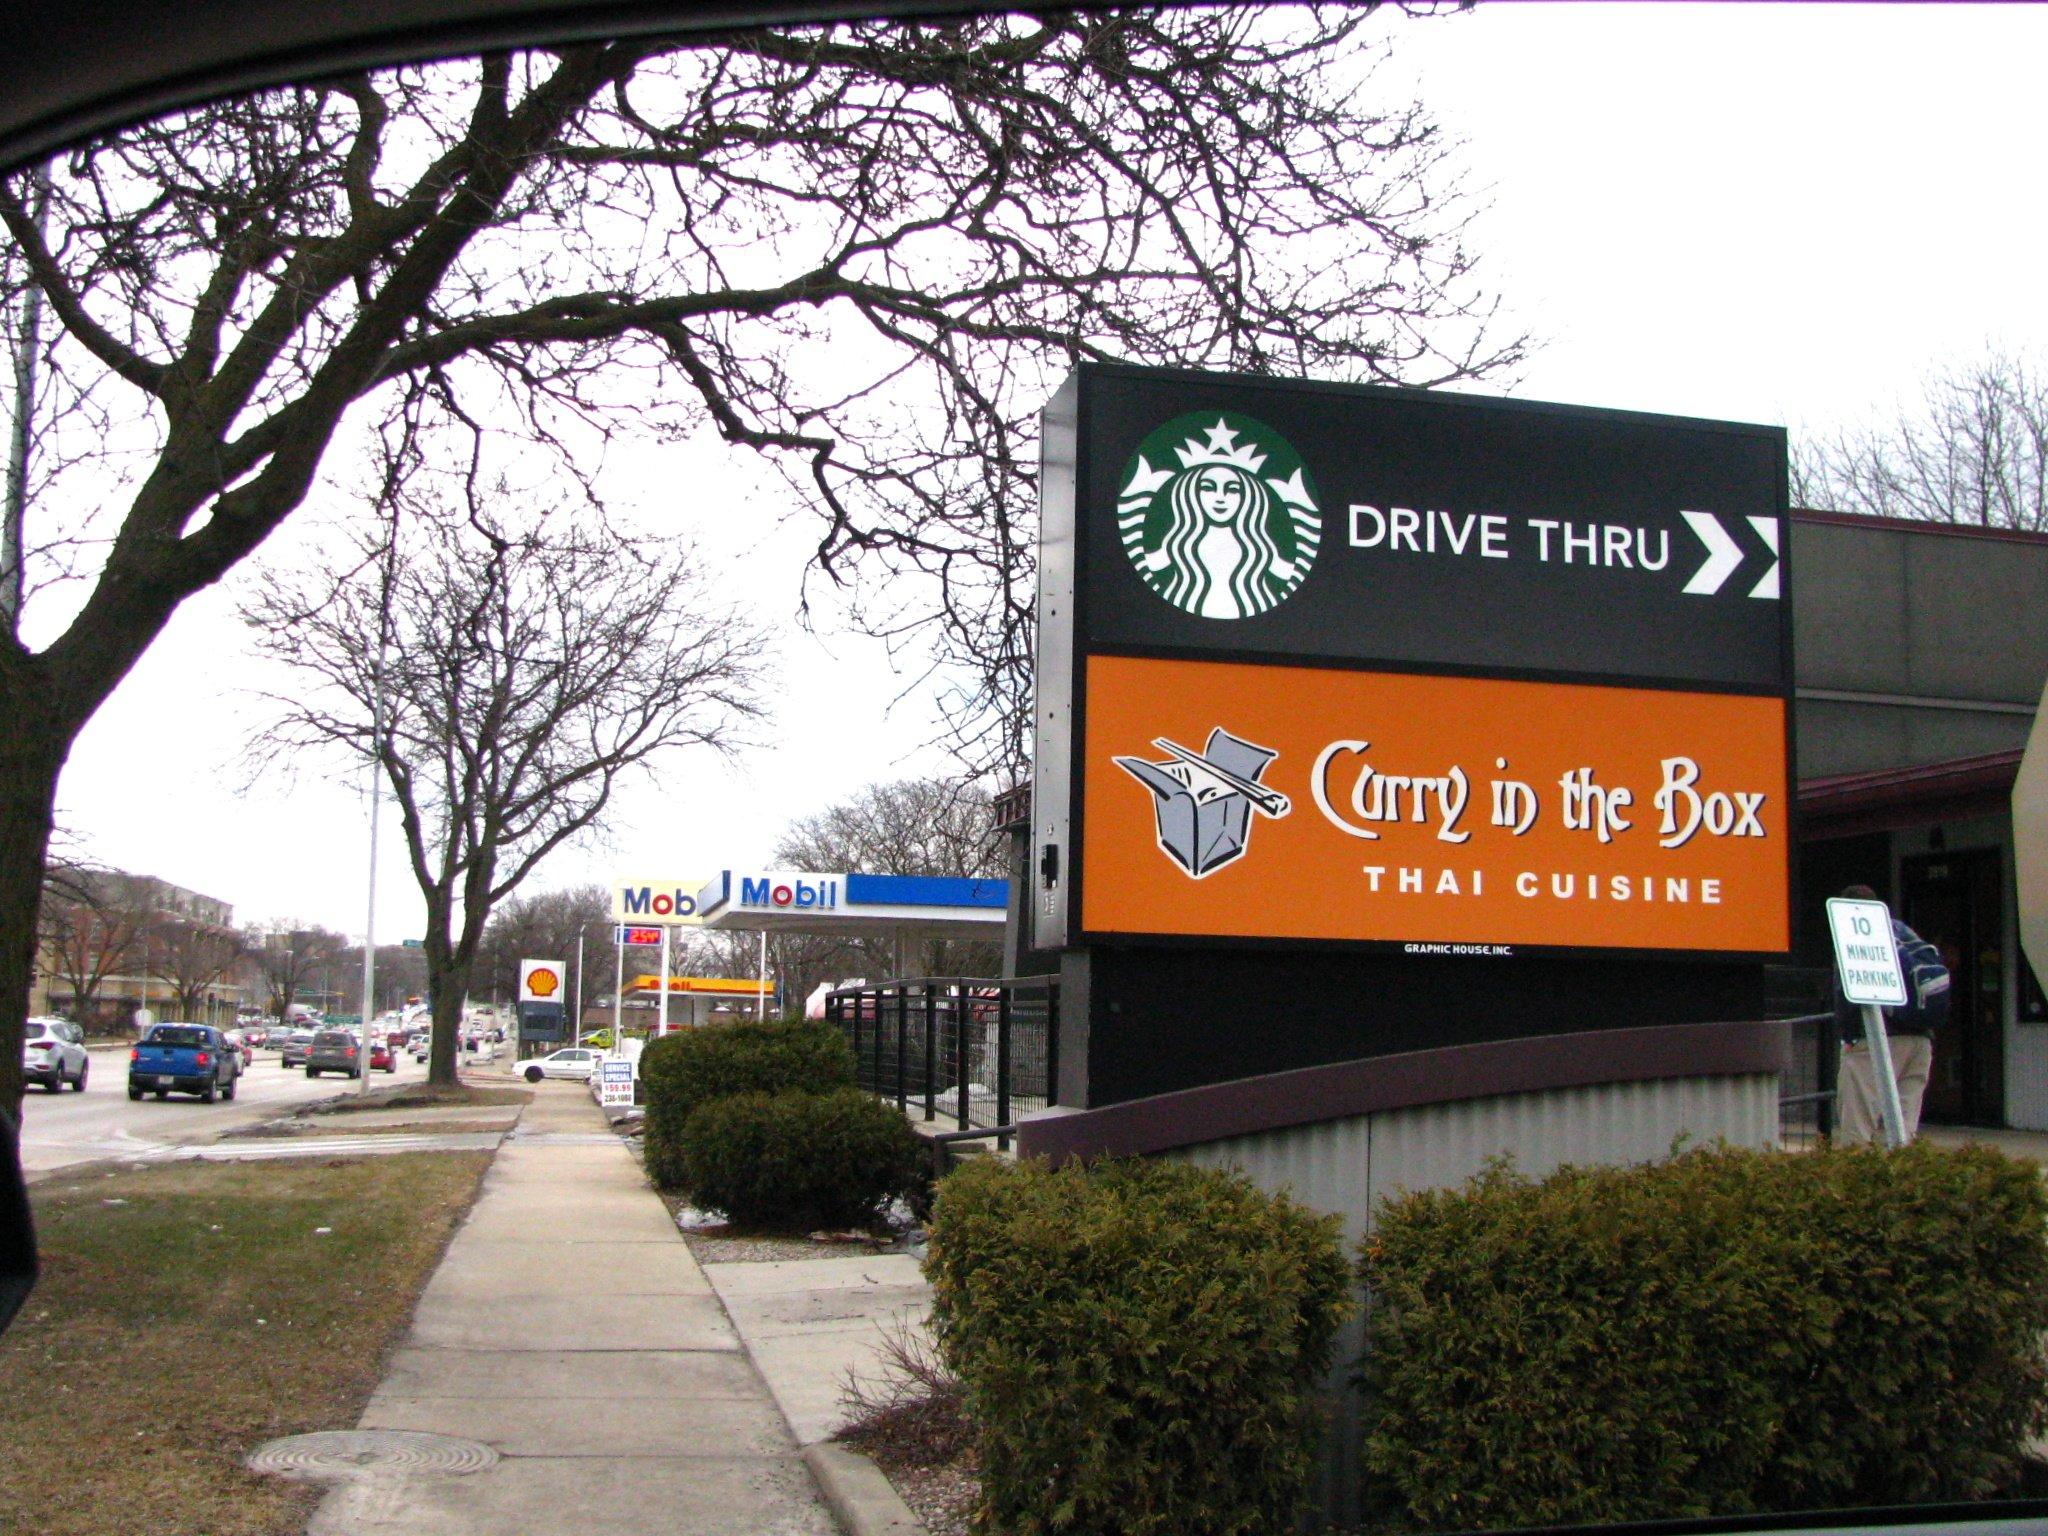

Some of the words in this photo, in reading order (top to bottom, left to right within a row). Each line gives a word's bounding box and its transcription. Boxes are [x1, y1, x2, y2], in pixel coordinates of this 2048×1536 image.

[1349, 504, 1508, 558] DRIVE
[1528, 519, 1669, 571] THRU
[1311, 739, 1470, 843] Curry
[1490, 757, 1538, 836] in
[1558, 768, 1632, 843] the
[1653, 757, 1766, 848] Box
[741, 877, 837, 909] Mobil
[1363, 867, 1482, 895] THAI
[1516, 872, 1721, 904] CUISINE
[624, 887, 697, 916] Mob
[1850, 916, 1871, 936] 10
[1404, 944, 1451, 953] GRAPHIC
[1846, 944, 1888, 962] MINUTE
[650, 979, 691, 991] Sell
[1848, 970, 1897, 987] PARKING
